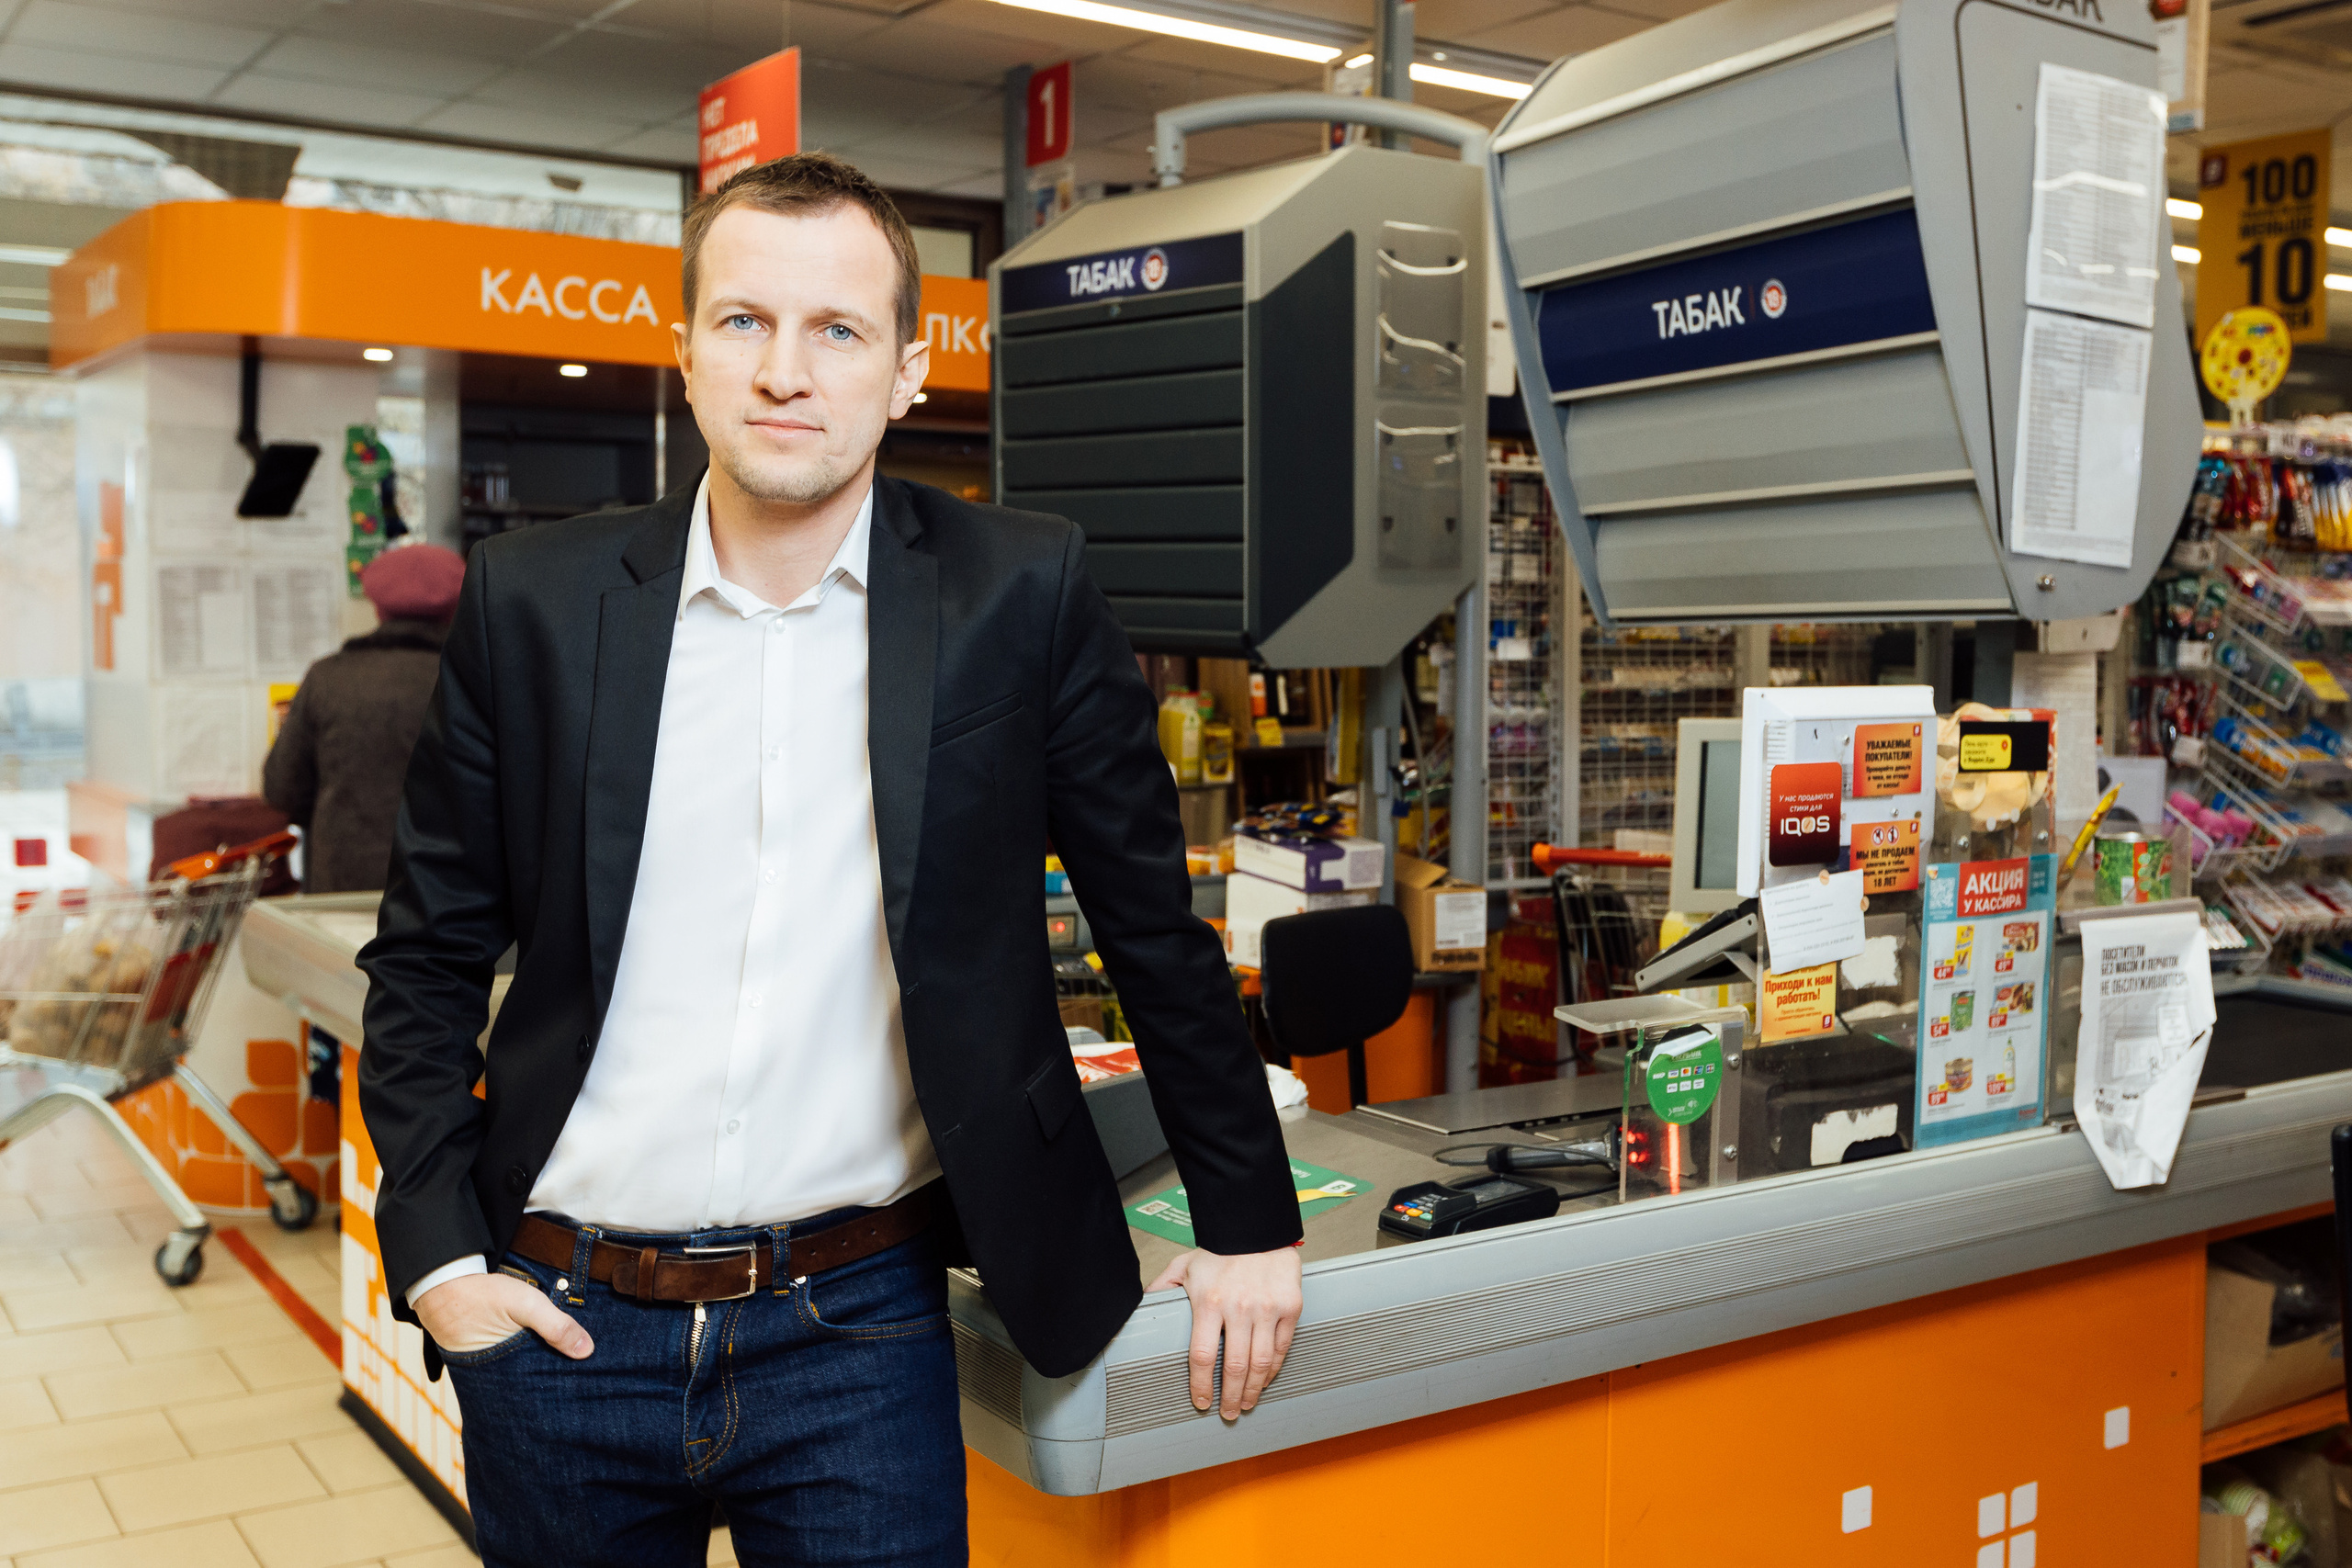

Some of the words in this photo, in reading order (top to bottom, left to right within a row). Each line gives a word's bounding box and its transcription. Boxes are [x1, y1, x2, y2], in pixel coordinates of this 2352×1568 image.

[1039, 80, 1056, 149] 1
[2240, 154, 2317, 204] 100
[1067, 256, 1136, 297] ТАБАК
[2236, 238, 2314, 306] 10
[481, 266, 660, 327] КАССА
[1652, 286, 1745, 340] ТАБАК
[1867, 739, 1911, 750] УВАЖАЕМЫЕ
[1865, 750, 1913, 762] ПОКУПАТЕЛИ!
[1798, 793, 1834, 802] продаются
[1781, 815, 1830, 837] IQOS
[1856, 849, 1869, 860] МЫ
[1871, 849, 1880, 859] НЕ
[1882, 846, 1915, 858] ПРОДАЕМ
[1964, 868, 2024, 896] АКЦИЯ
[1963, 899, 1972, 913] У
[1974, 893, 2021, 912] КАССИРА
[1765, 979, 1804, 995] Приходи
[1807, 978, 1813, 987] к
[1815, 975, 1833, 986] нам
[1777, 988, 1820, 1008] работать!
